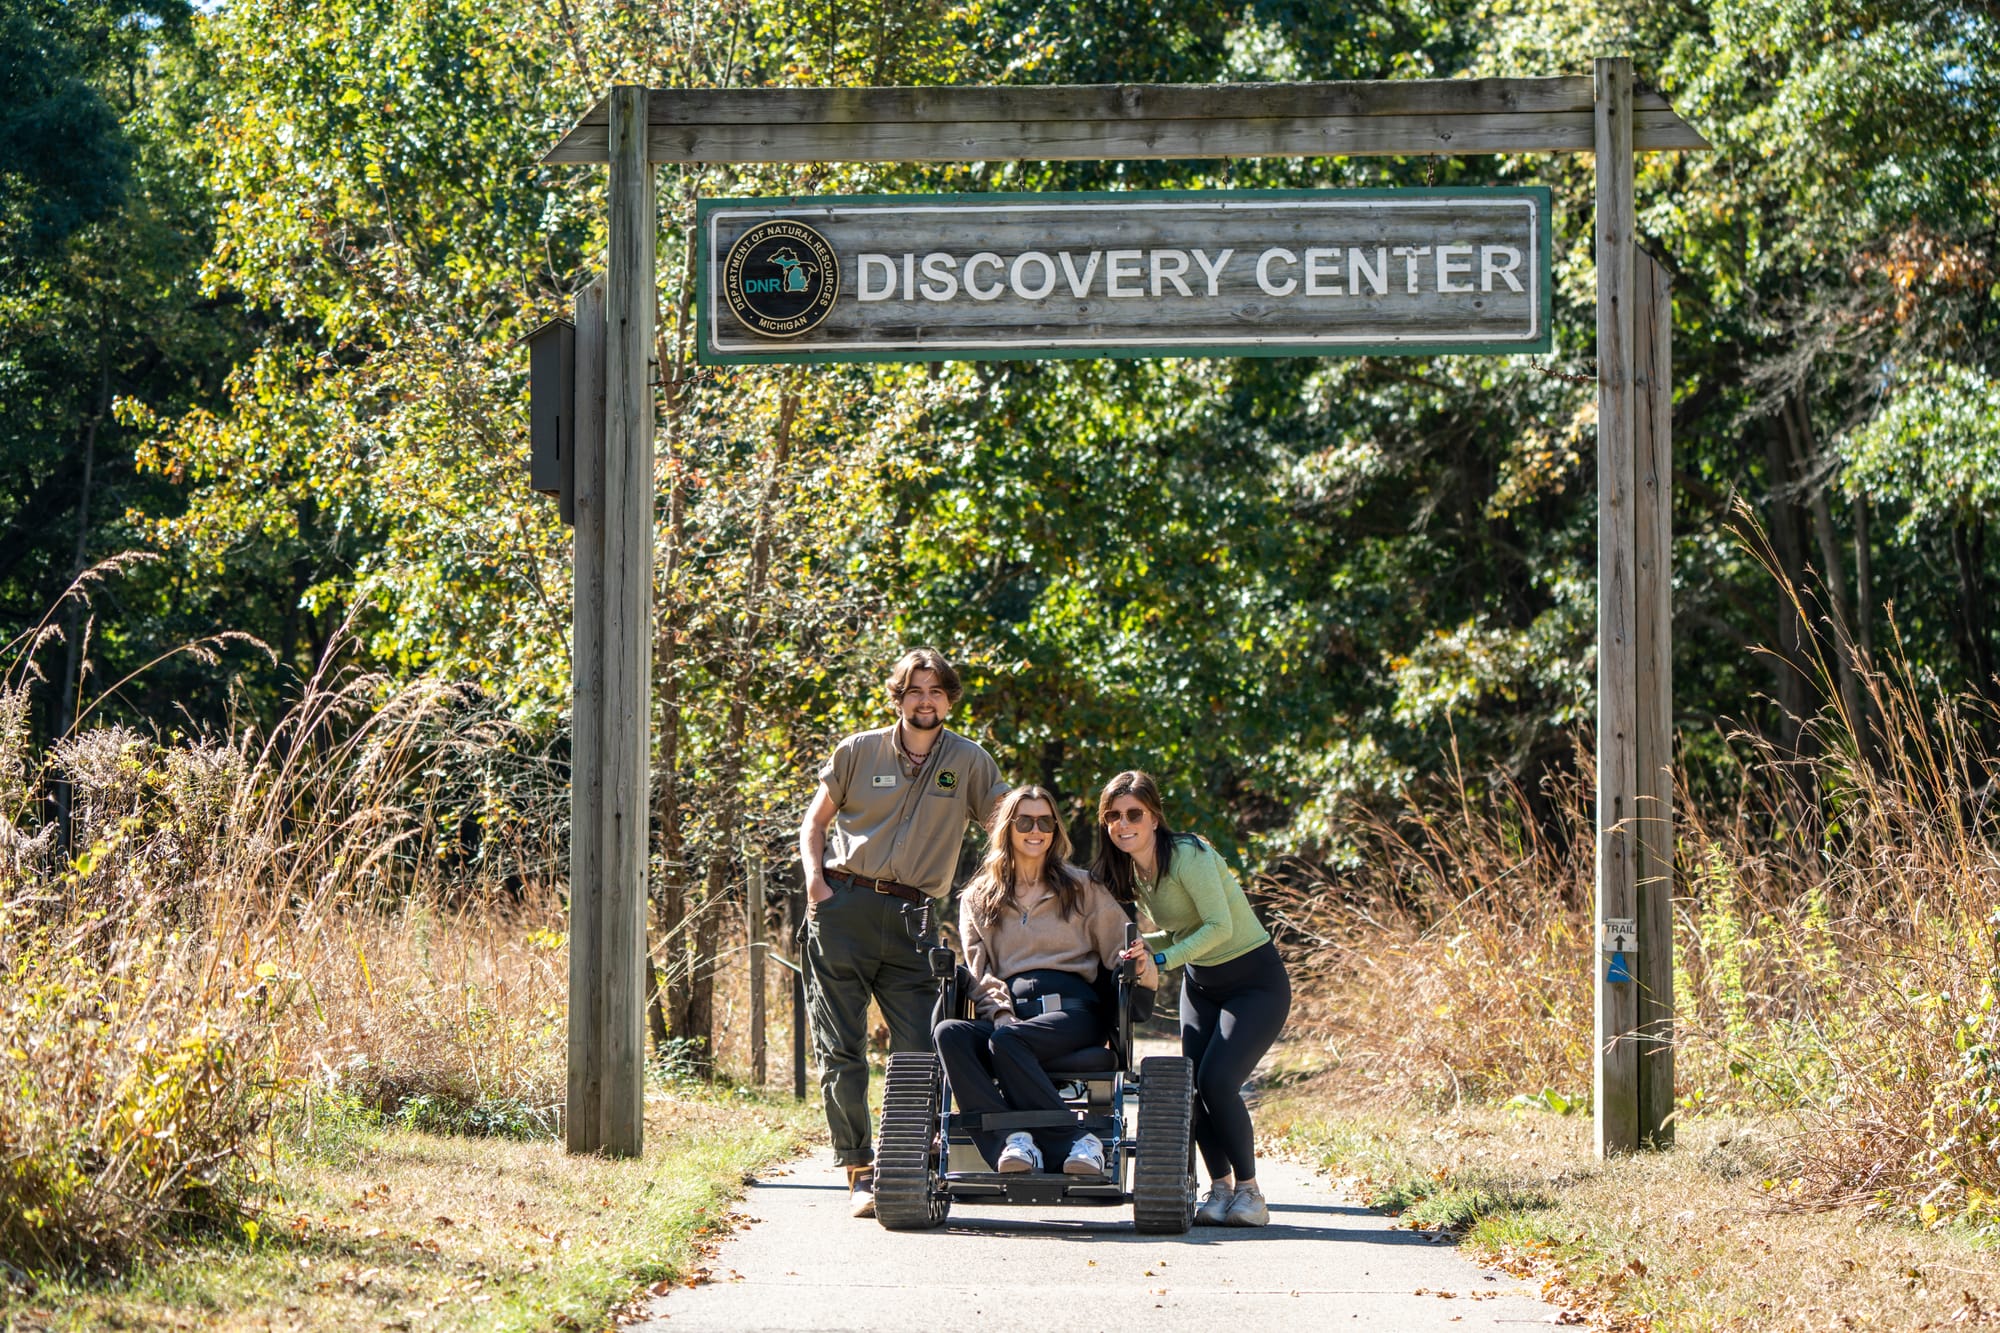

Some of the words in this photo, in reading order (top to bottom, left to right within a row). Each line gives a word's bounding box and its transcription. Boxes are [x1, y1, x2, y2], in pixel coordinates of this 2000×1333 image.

[729, 240, 752, 311] DEPARTMENT
[751, 230, 765, 242] OF
[767, 225, 813, 244] NATURAL
[813, 241, 833, 307] RESOURCES
[857, 248, 1235, 302] DISCOVERY
[1255, 245, 1525, 297] CENTER
[745, 278, 781, 293] DNR
[758, 315, 808, 331] MICHIGAN
[1606, 924, 1635, 935] TRAIL
